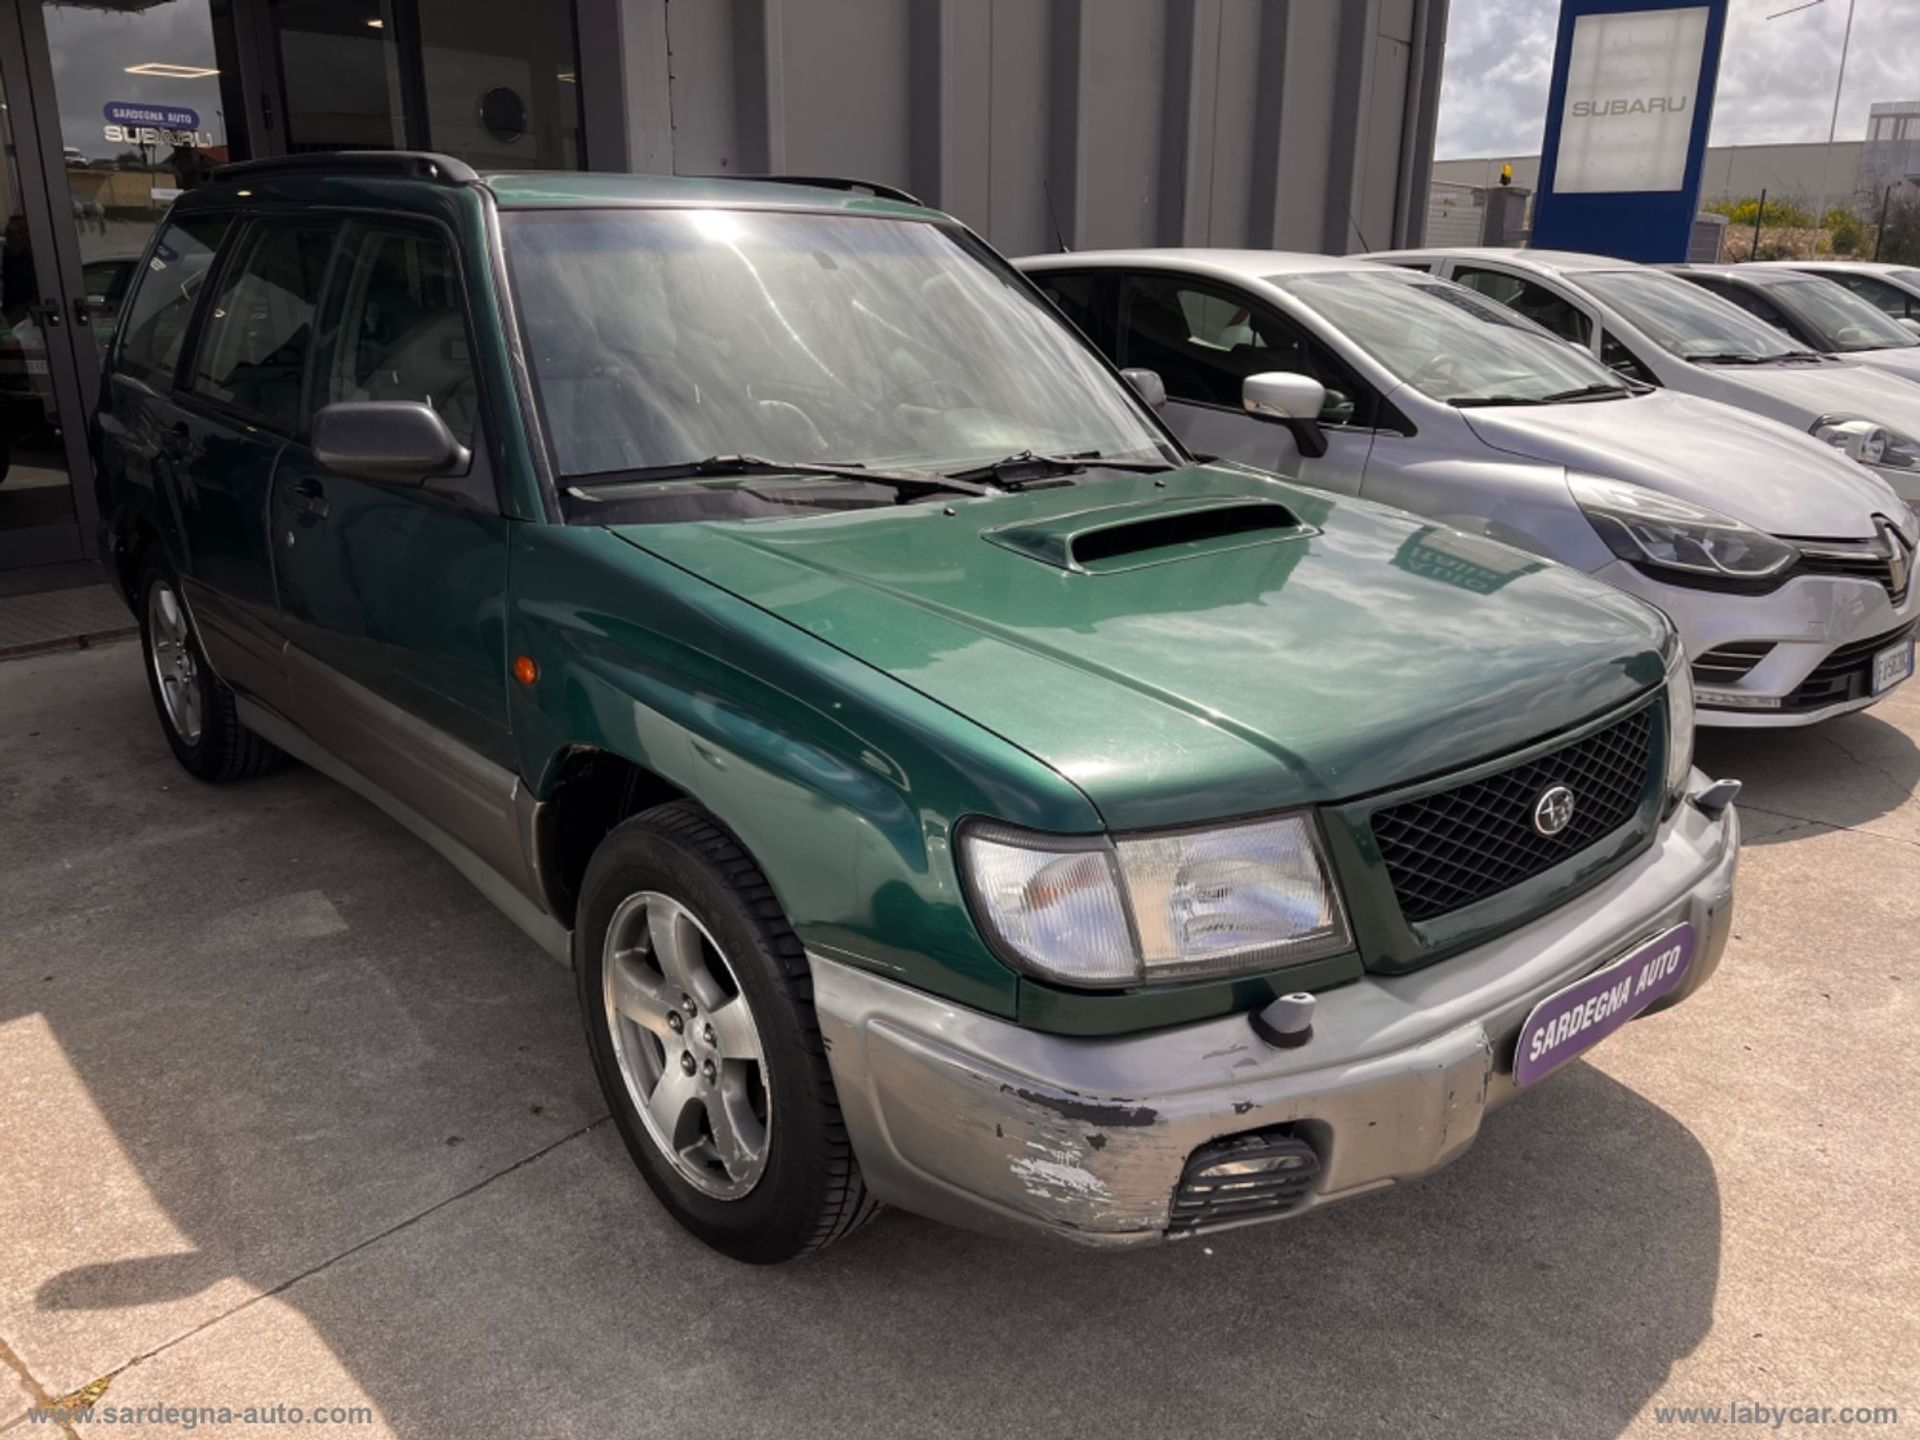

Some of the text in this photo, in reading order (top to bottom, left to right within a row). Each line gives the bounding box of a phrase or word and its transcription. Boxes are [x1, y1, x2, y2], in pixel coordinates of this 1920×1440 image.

[112, 108, 164, 121] SARDEGNA
[167, 113, 192, 124] AUTO
[1572, 96, 1687, 117] SUBARU
[1529, 945, 1682, 1062] SARDEGNA AUTO
